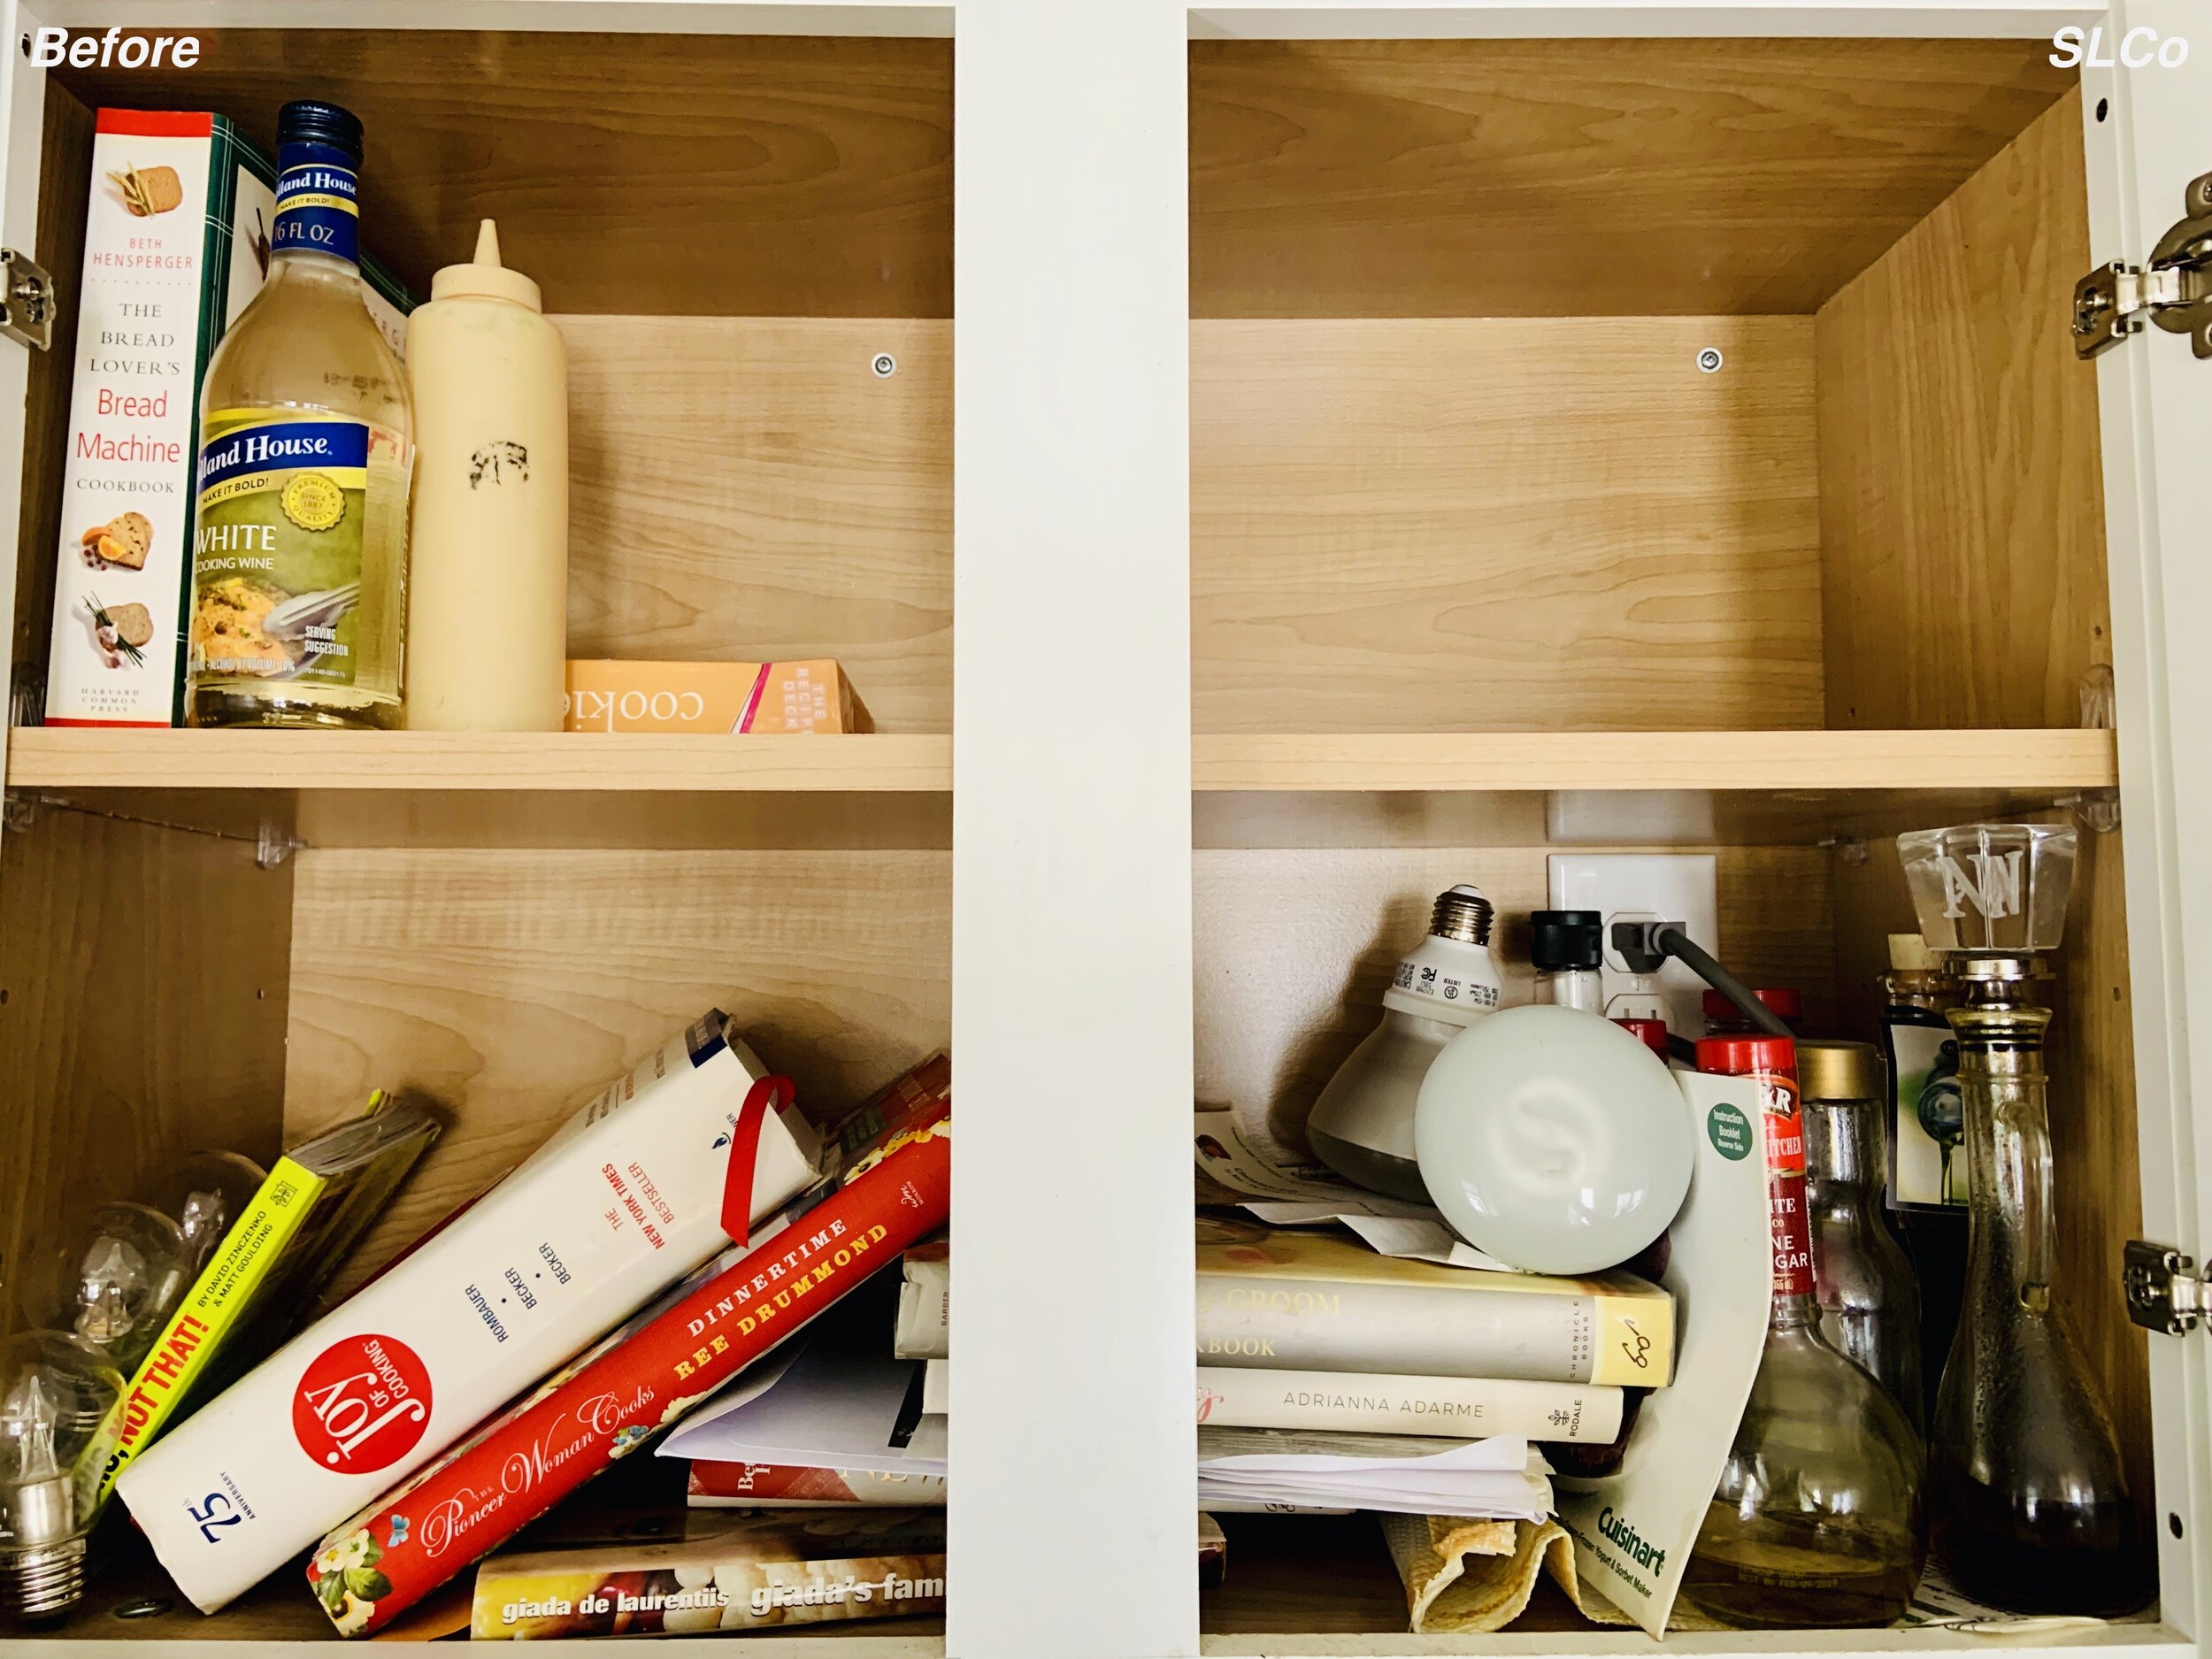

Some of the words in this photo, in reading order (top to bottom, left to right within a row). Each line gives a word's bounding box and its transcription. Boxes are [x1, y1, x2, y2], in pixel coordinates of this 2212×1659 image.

[314, 172, 357, 196] House
[129, 238, 162, 250] BETH
[289, 222, 305, 239] FL
[310, 224, 334, 245] OZ
[93, 253, 193, 269] HENSPERGER
[119, 303, 162, 318] THE
[101, 331, 174, 347] BREAD
[89, 358, 180, 375] LOVER'S
[98, 388, 167, 418] Bread
[77, 432, 180, 462] Machine
[245, 434, 328, 464] House
[77, 479, 174, 493] COOKBOOK
[203, 488, 222, 503] MAKE
[224, 485, 233, 495] IT
[235, 478, 269, 492] BOLD!
[293, 480, 335, 499] PREMIUM
[301, 492, 326, 502] SINCE
[196, 525, 276, 555] WHITE
[238, 557, 274, 570] WINE
[305, 625, 336, 641] SERVING
[304, 641, 349, 657] SUGGESTION
[782, 680, 798, 729] DECK
[813, 684, 826, 719] THE
[1713, 1109, 1744, 1125] Instruction
[1718, 1125, 1740, 1140] Booklet
[602, 1163, 628, 1198] TIMES
[627, 1161, 674, 1225] BESTSELLER
[604, 1207, 624, 1232] THE
[623, 1194, 647, 1225] YORK
[642, 1224, 665, 1249] NEW
[197, 1294, 210, 1308] BY
[206, 1264, 229, 1294] DAVID
[227, 1210, 266, 1264] ZINCZENKO
[213, 1298, 223, 1308] &
[219, 1272, 239, 1298] MATT
[236, 1224, 273, 1272] GOULDING
[539, 1242, 572, 1285] BECKER
[1774, 1252, 1809, 1269] GAR
[504, 1267, 537, 1310] BECKER
[687, 1218, 847, 1338] DINNERTIME
[465, 1284, 509, 1343] ROMBAUER
[673, 1334, 730, 1380] REE
[737, 1224, 887, 1336] DRUMMOND
[1226, 1288, 1341, 1317] GROOM
[1570, 1301, 1579, 1379] CHRONICLE
[110, 1385, 158, 1447] NOT
[142, 1313, 210, 1390] THAT!
[364, 1339, 409, 1399] COOKING
[368, 1390, 389, 1409] OF
[1283, 1392, 1390, 1411] ADRIANNA
[1399, 1400, 1485, 1417] ADARME
[1569, 1399, 1582, 1437] RODALE
[420, 1487, 507, 1557] Pioneer
[501, 1413, 595, 1494] Woman
[576, 1386, 655, 1434] Cooks
[219, 1471, 257, 1520] ANNIVERSARY
[1597, 1506, 1665, 1578] Cuisinart
[1595, 1545, 1613, 1569] Yogurt
[1615, 1563, 1634, 1586] Sorbet
[1633, 1577, 1652, 1600] Maker
[502, 1599, 572, 1625] giada
[580, 1594, 609, 1616] de
[618, 1586, 729, 1614] laurentiis
[751, 1576, 872, 1617] giada's
[884, 1572, 945, 1602] fam
